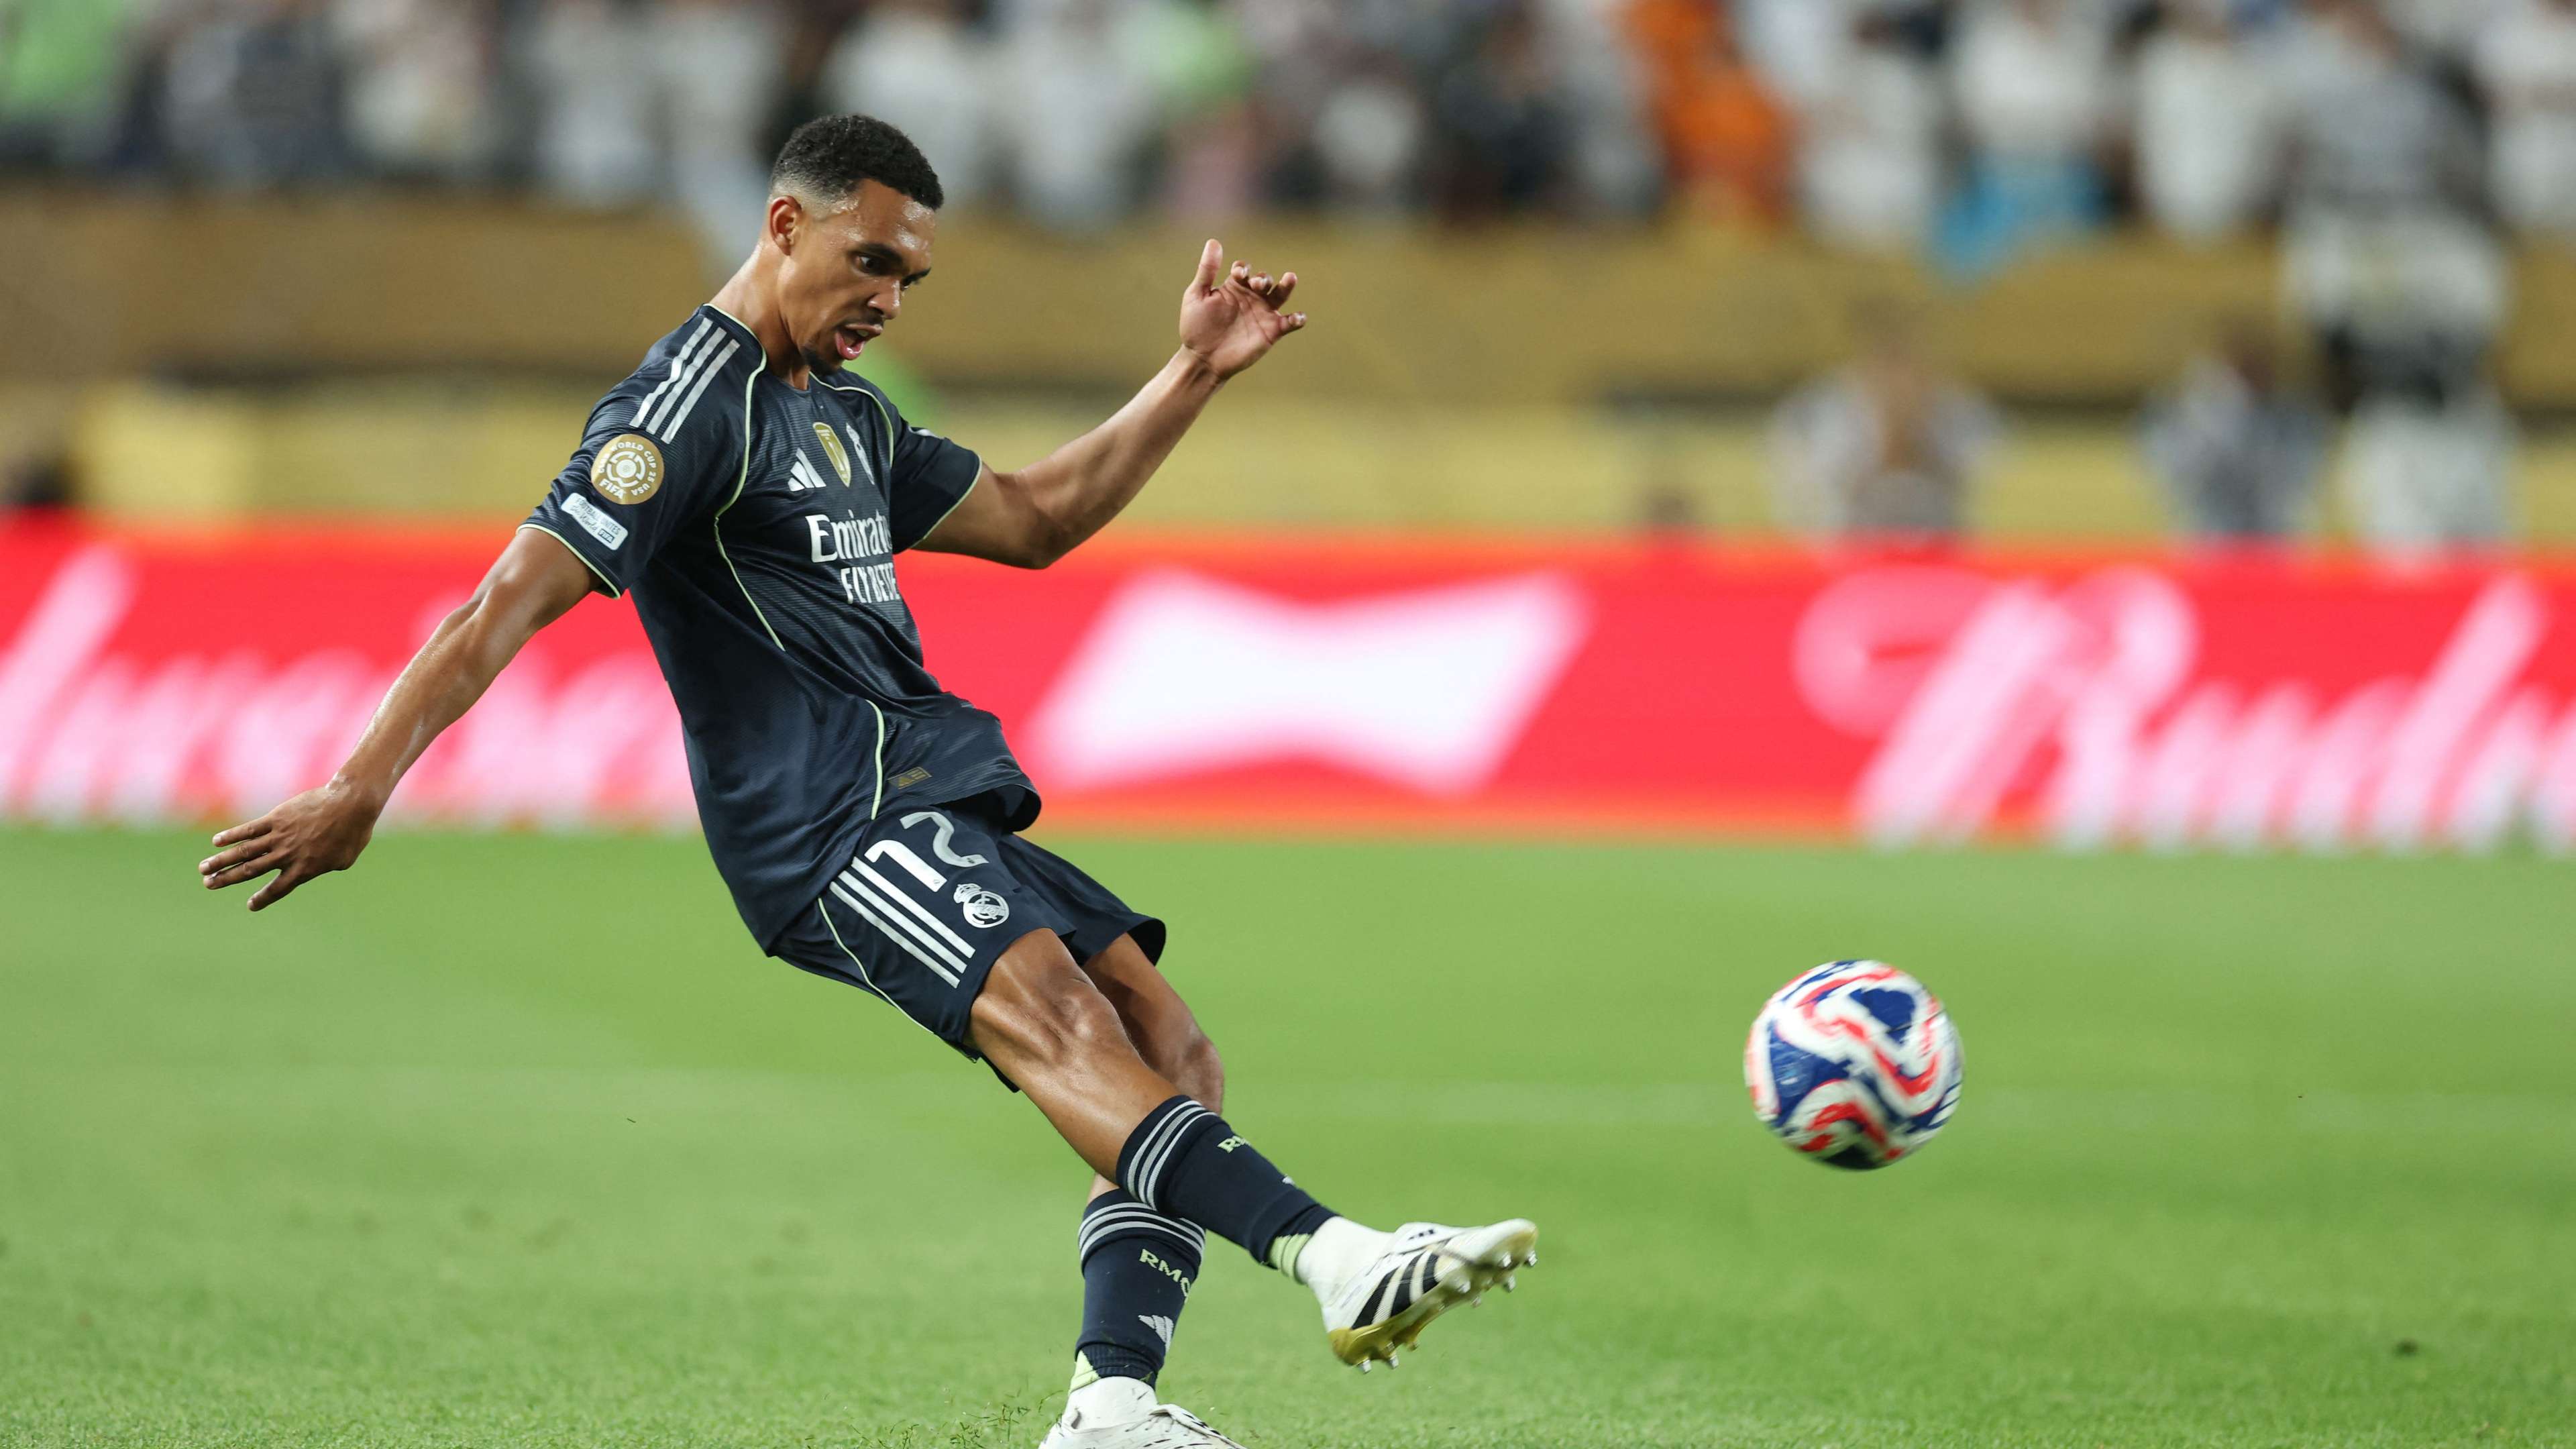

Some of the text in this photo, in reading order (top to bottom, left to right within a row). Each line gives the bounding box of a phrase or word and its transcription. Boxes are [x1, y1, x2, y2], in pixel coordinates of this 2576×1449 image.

[610, 441, 644, 451] WORLD
[644, 450, 657, 468] CUP
[647, 471, 656, 483] 25
[599, 478, 626, 500] FIFA
[631, 483, 651, 496] USA
[597, 528, 614, 543] FIFA
[840, 566, 873, 604] FLY
[863, 811, 990, 893] 12
